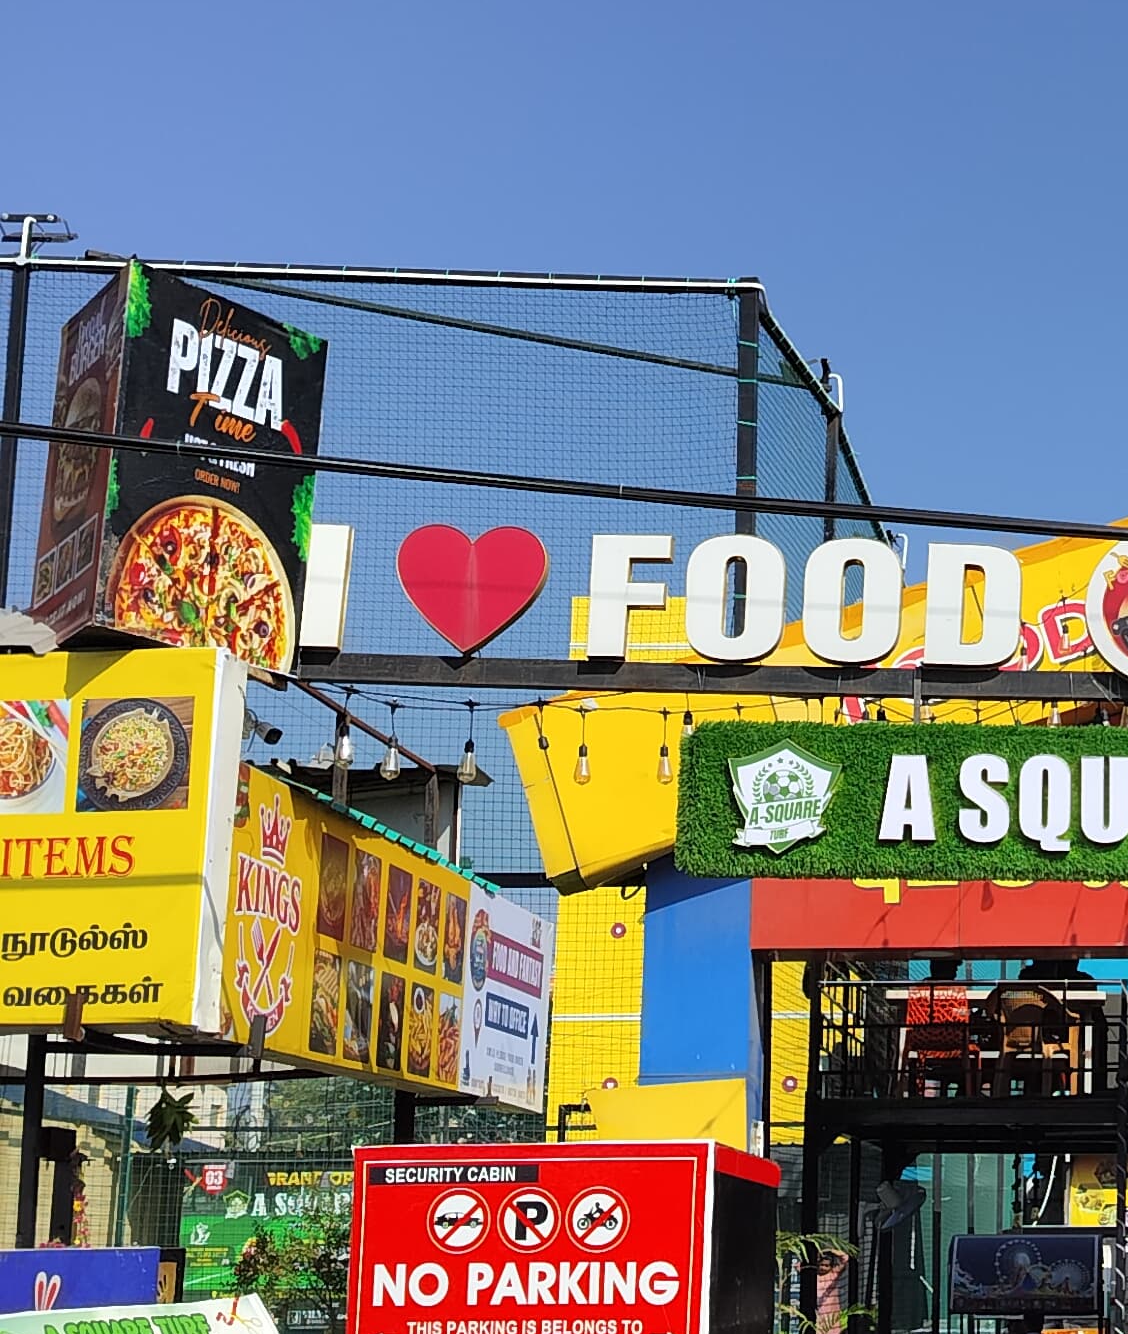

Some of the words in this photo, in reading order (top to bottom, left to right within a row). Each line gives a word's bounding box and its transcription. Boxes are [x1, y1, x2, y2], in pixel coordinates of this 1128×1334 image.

[199, 297, 272, 358] Delicious
[166, 317, 285, 432] PIZZA
[194, 468, 219, 486] ORDER
[588, 534, 1022, 666] FOOD
[748, 798, 822, 826] A-SQUARE
[879, 754, 936, 842] A
[769, 827, 789, 841] TURF
[1, 835, 136, 880] ITEMS
[234, 853, 302, 936] KINGS
[1, 922, 148, 962] நூடுல்ஸ்
[3, 976, 164, 1007] வகைகள்
[205, 1170, 223, 1185] 03
[385, 1167, 463, 1184] SECURITY
[467, 1167, 516, 1183] CABIN
[251, 1193, 267, 1217] A
[372, 1262, 449, 1307] NO
[465, 1260, 680, 1306] PARKING
